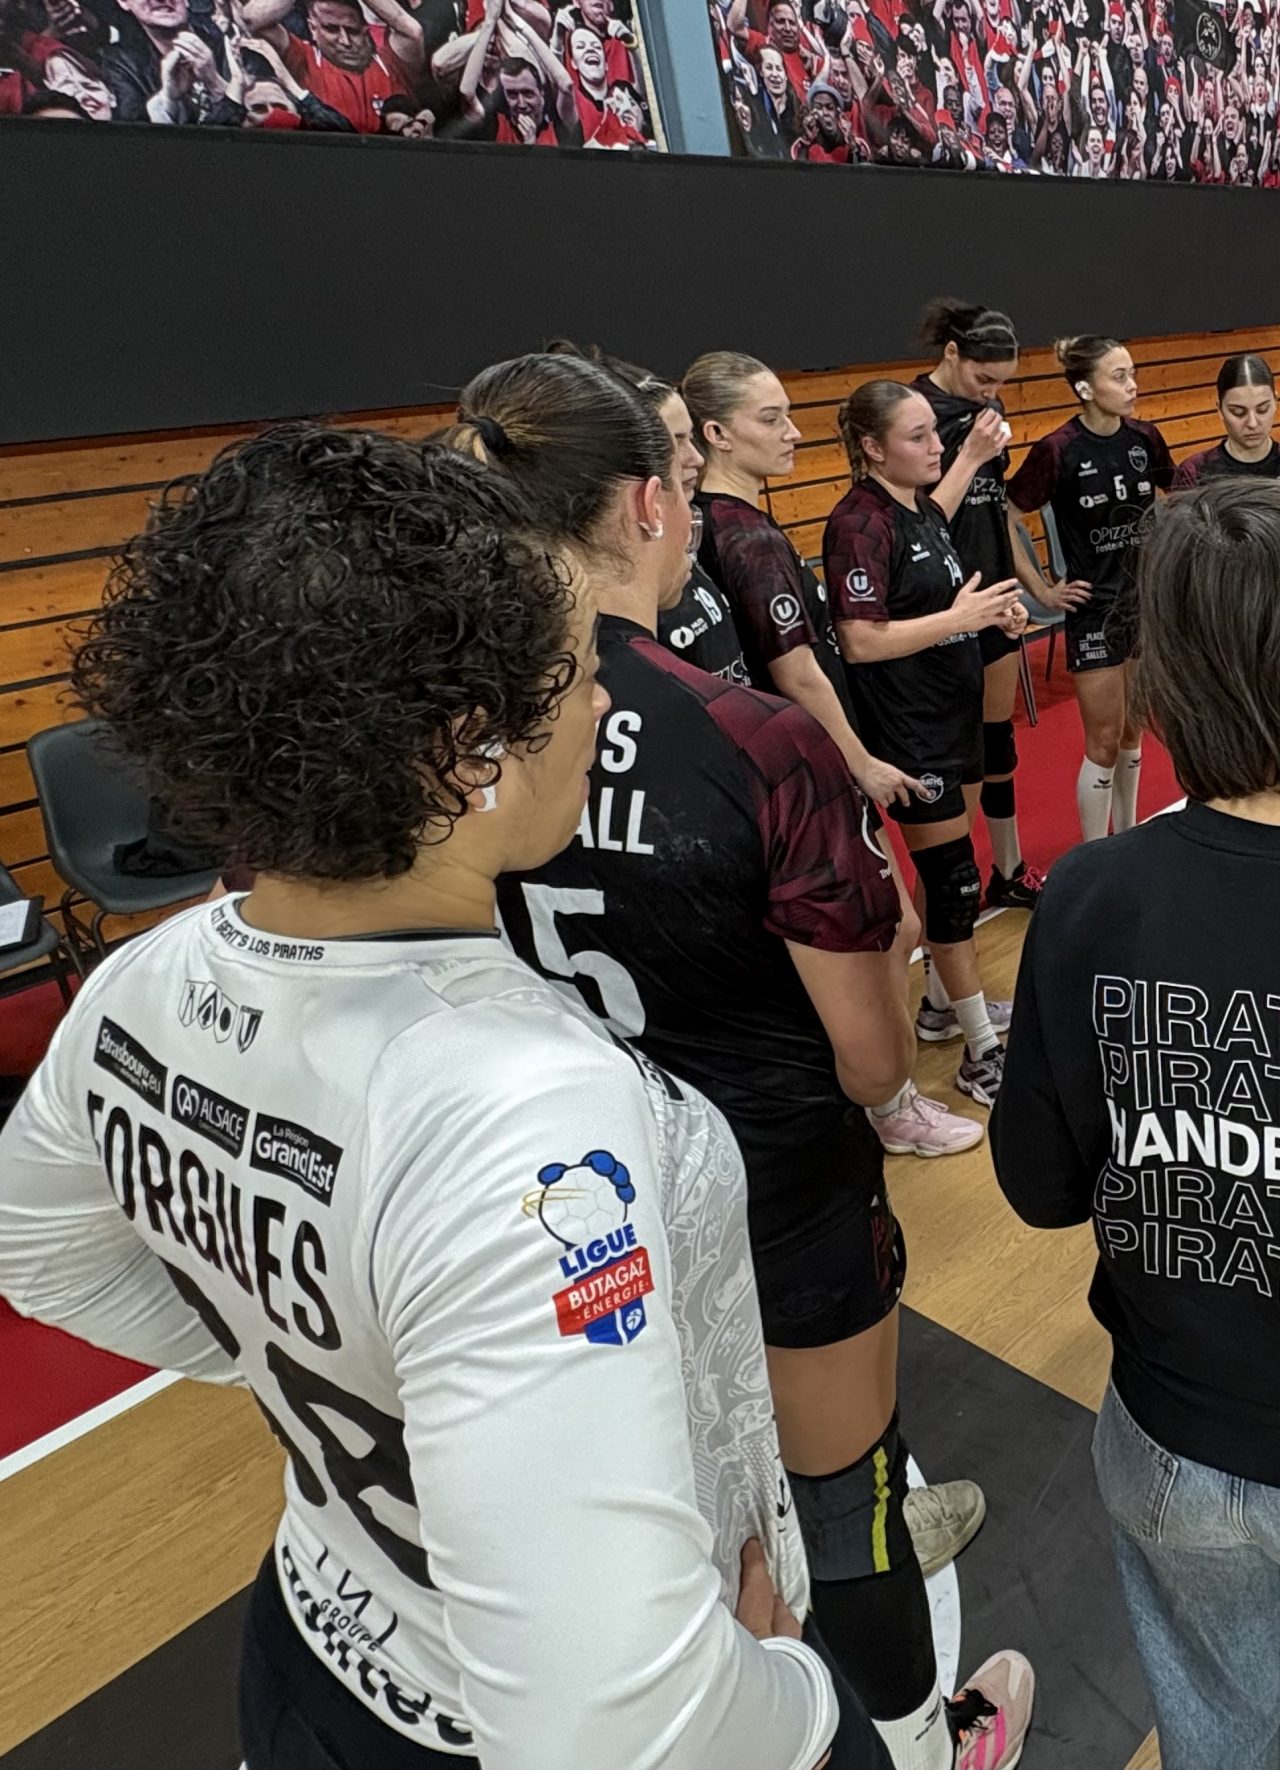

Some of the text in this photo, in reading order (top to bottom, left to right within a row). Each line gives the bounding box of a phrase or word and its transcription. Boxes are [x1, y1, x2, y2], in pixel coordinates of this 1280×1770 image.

[1114, 474, 1127, 500] 5
[693, 586, 722, 625] 19
[776, 601, 793, 619] U
[248, 937, 271, 955] LOS
[272, 943, 325, 961] PIRATHS
[201, 1098, 244, 1141] ALSACE
[273, 1124, 284, 1137] La
[558, 1223, 638, 1279] LIGUE
[568, 1256, 647, 1311] BUTAGAZ
[319, 1599, 381, 1652] GROUPE
